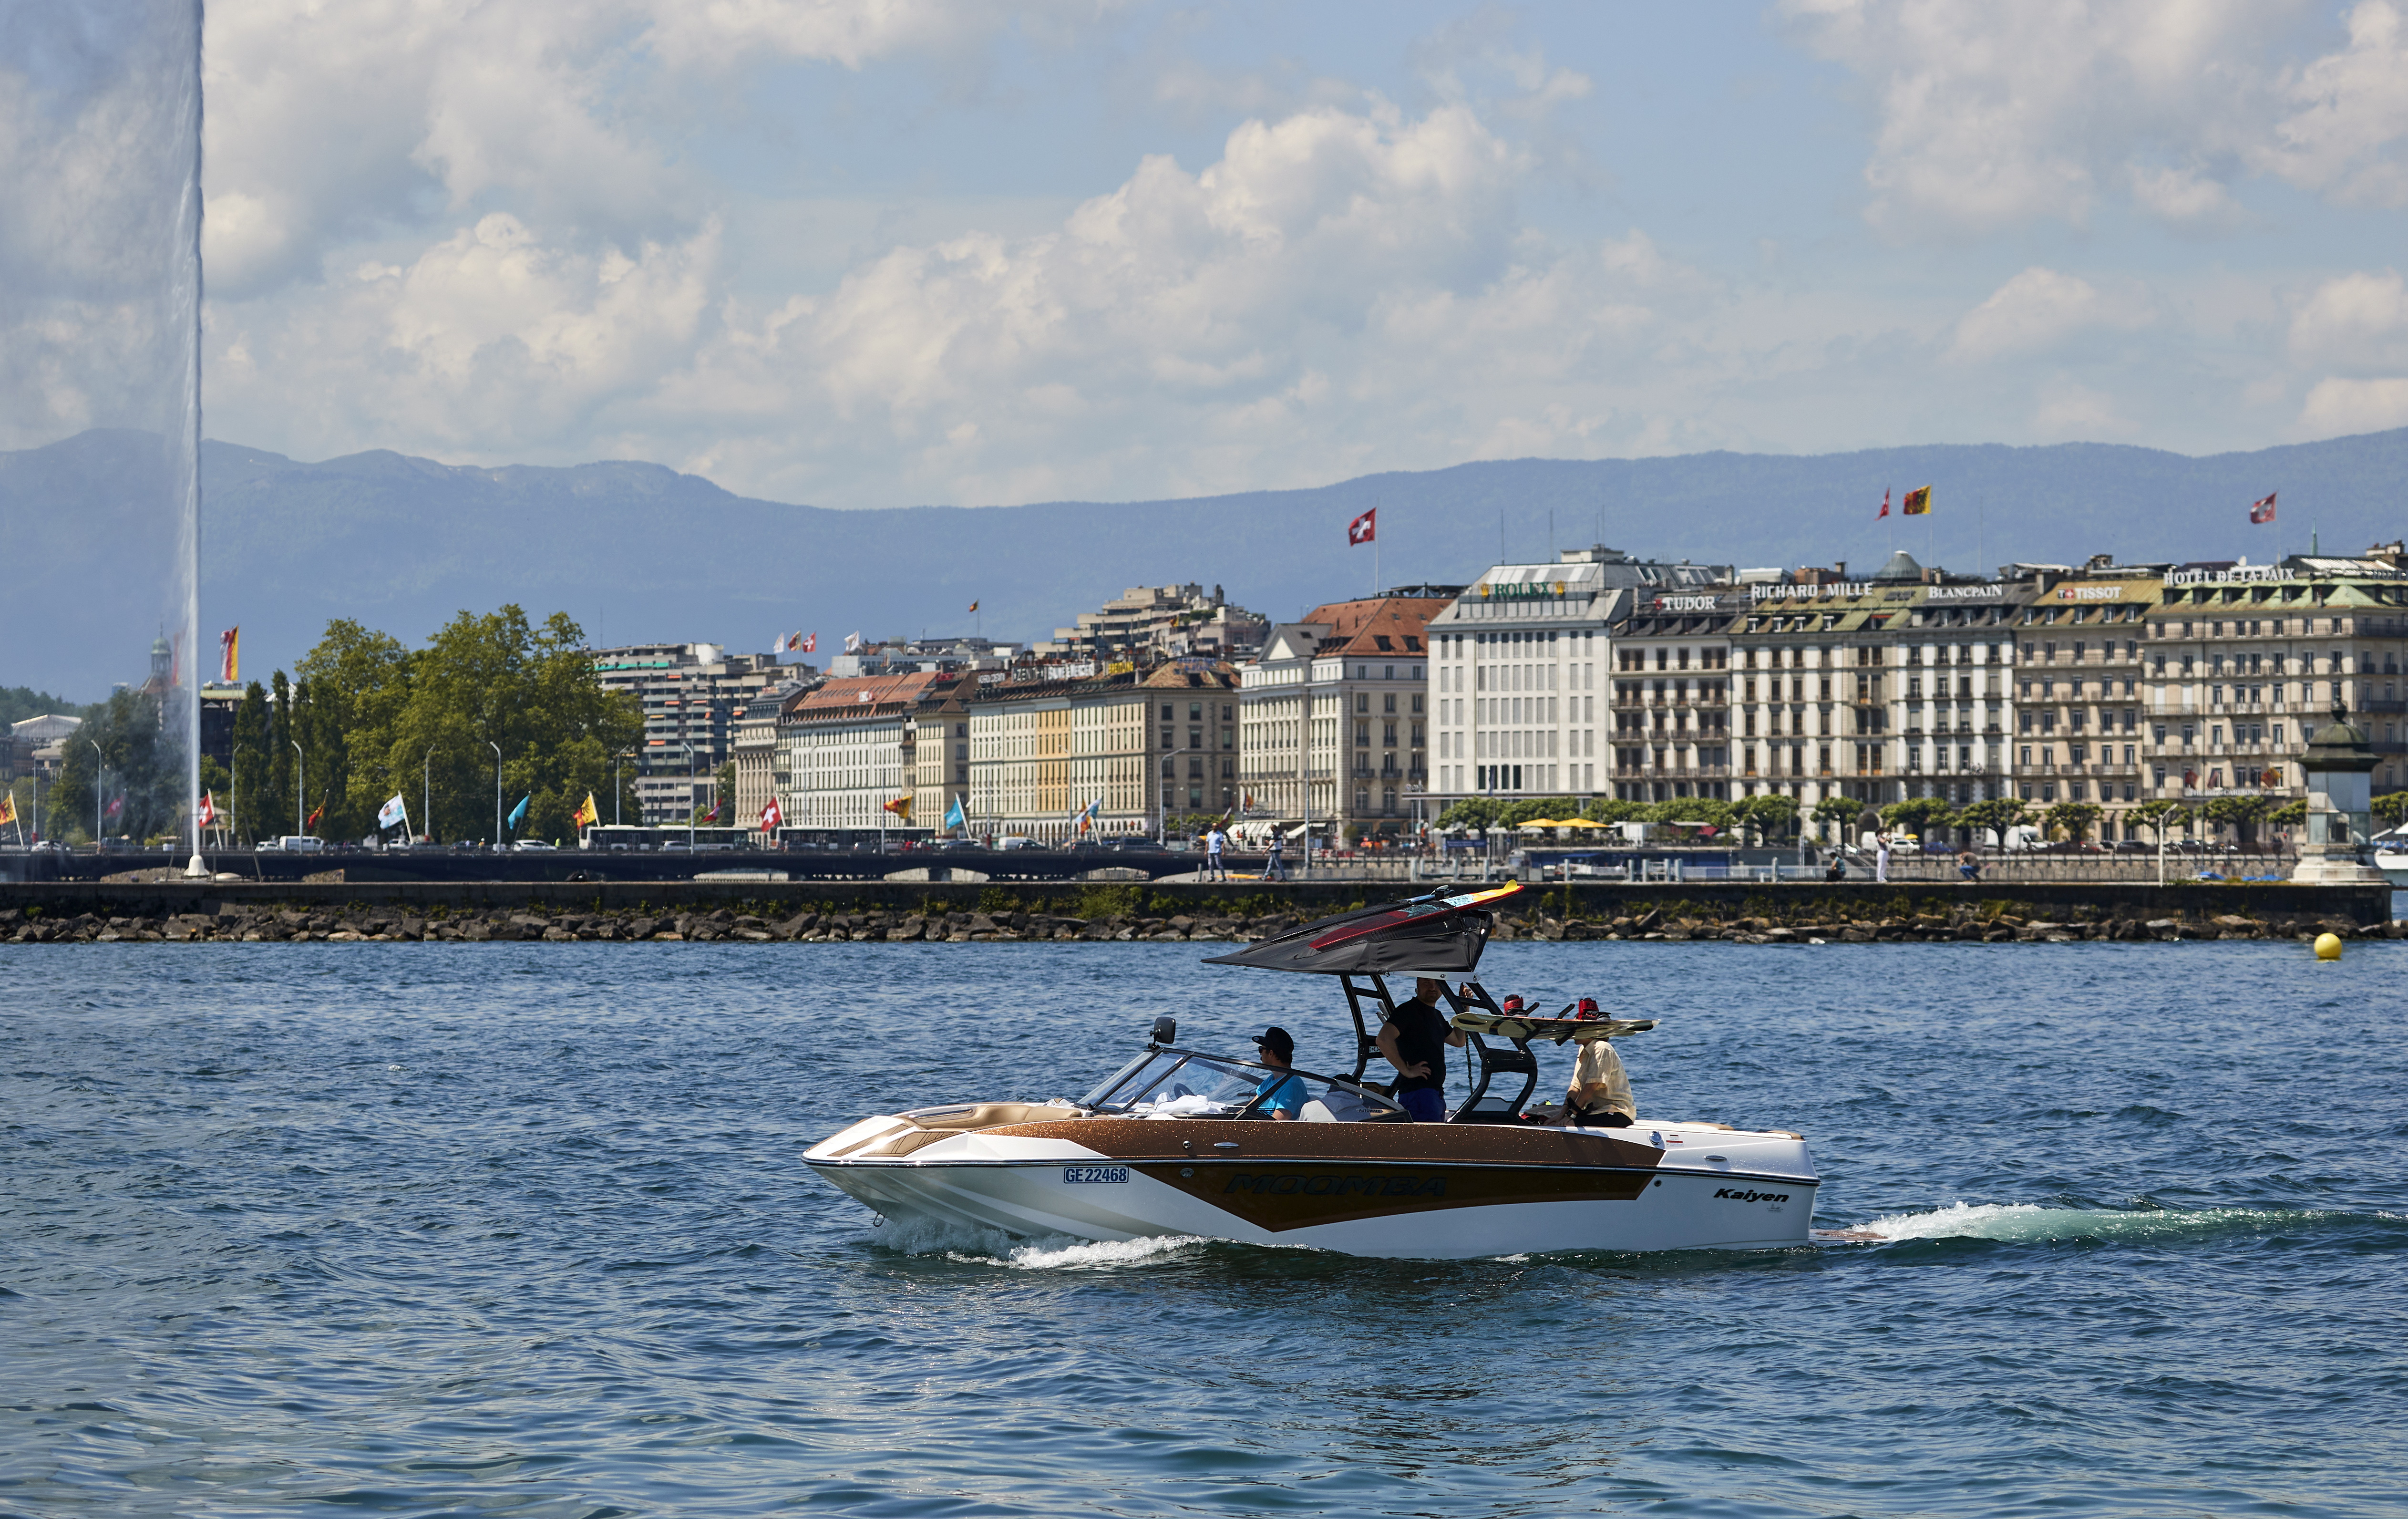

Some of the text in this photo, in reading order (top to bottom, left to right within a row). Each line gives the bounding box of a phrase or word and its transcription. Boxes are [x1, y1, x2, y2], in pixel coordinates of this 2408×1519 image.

[2163, 568, 2295, 586] HOTEL DE LA PAIX
[1494, 581, 1550, 597] ROLEX
[1751, 582, 1873, 599] RICHARD MILLE
[1928, 583, 2003, 599] BLANCPAIN
[2075, 586, 2122, 599] TISSOT
[1662, 596, 1716, 611] TUDOR
[1066, 1168, 1127, 1182] GE 22468
[1224, 1174, 1447, 1197] MOOMBA
[1713, 1188, 1789, 1202] Kaiyen
